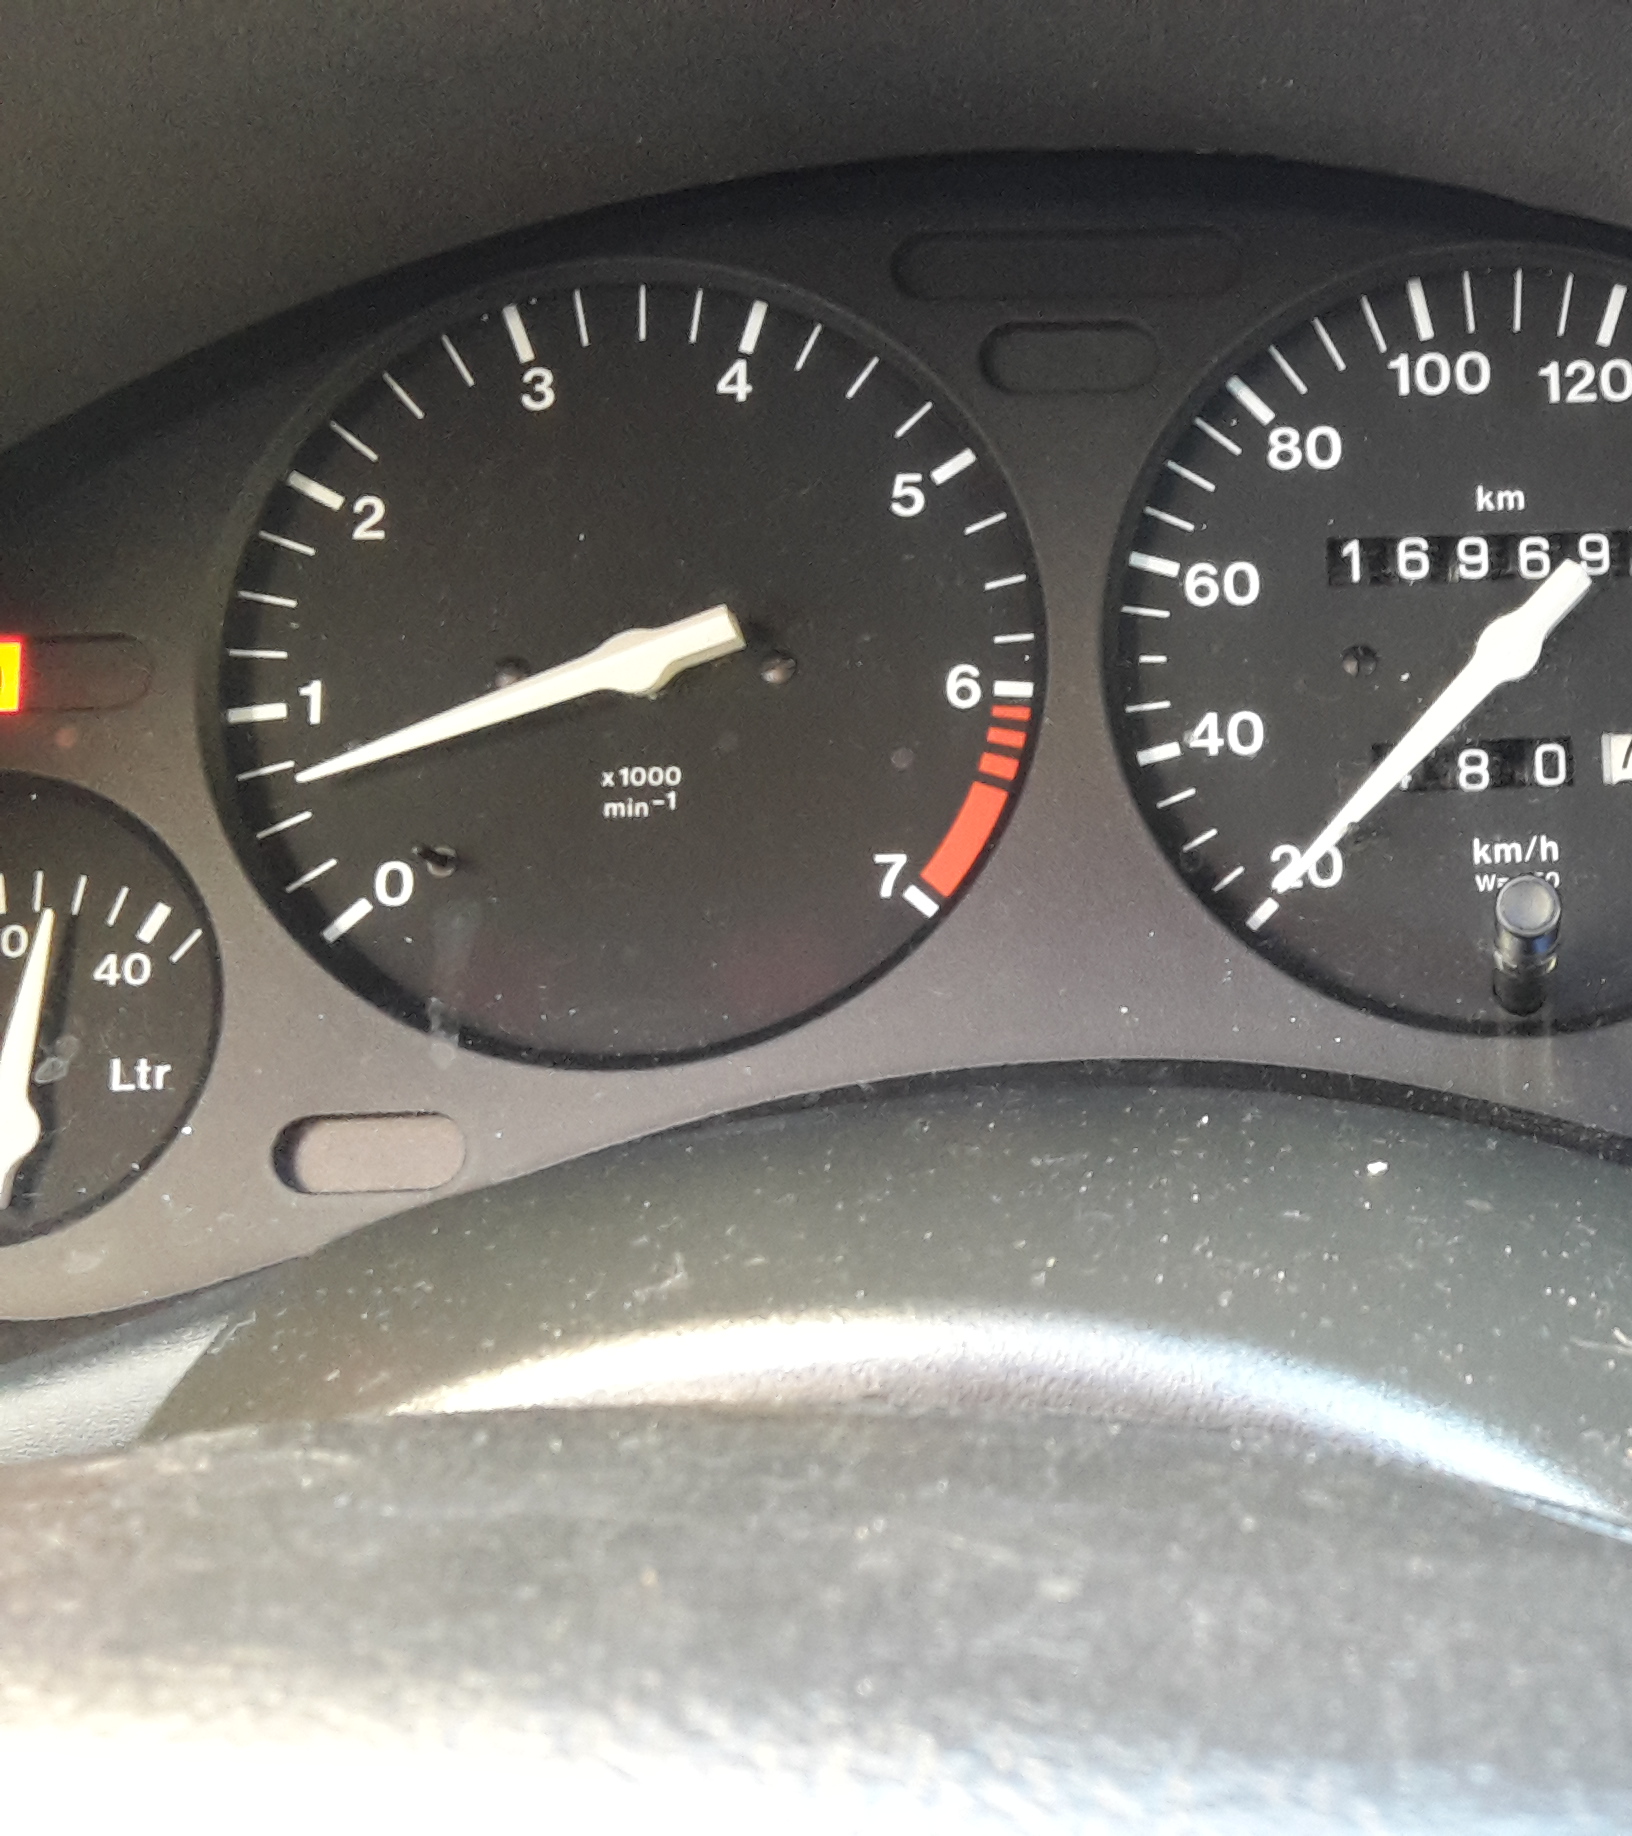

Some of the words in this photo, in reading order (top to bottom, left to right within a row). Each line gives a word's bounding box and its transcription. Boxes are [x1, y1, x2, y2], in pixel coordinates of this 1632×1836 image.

[520, 366, 556, 411] 3
[716, 359, 753, 402] 4
[1388, 351, 1491, 397] 100
[1266, 425, 1342, 471] 80
[890, 472, 926, 517] 5
[1475, 484, 1525, 511] km
[351, 495, 387, 540] 2
[1183, 561, 1260, 607] 60
[298, 679, 323, 725] 1
[945, 663, 982, 710] 6
[1187, 710, 1264, 757] 40
[1270, 844, 1344, 893] 20
[1472, 834, 1559, 864] km/h
[373, 860, 414, 907] 0
[873, 853, 909, 898] 7
[93, 952, 152, 986] 40
[109, 1057, 172, 1092] Ltr
